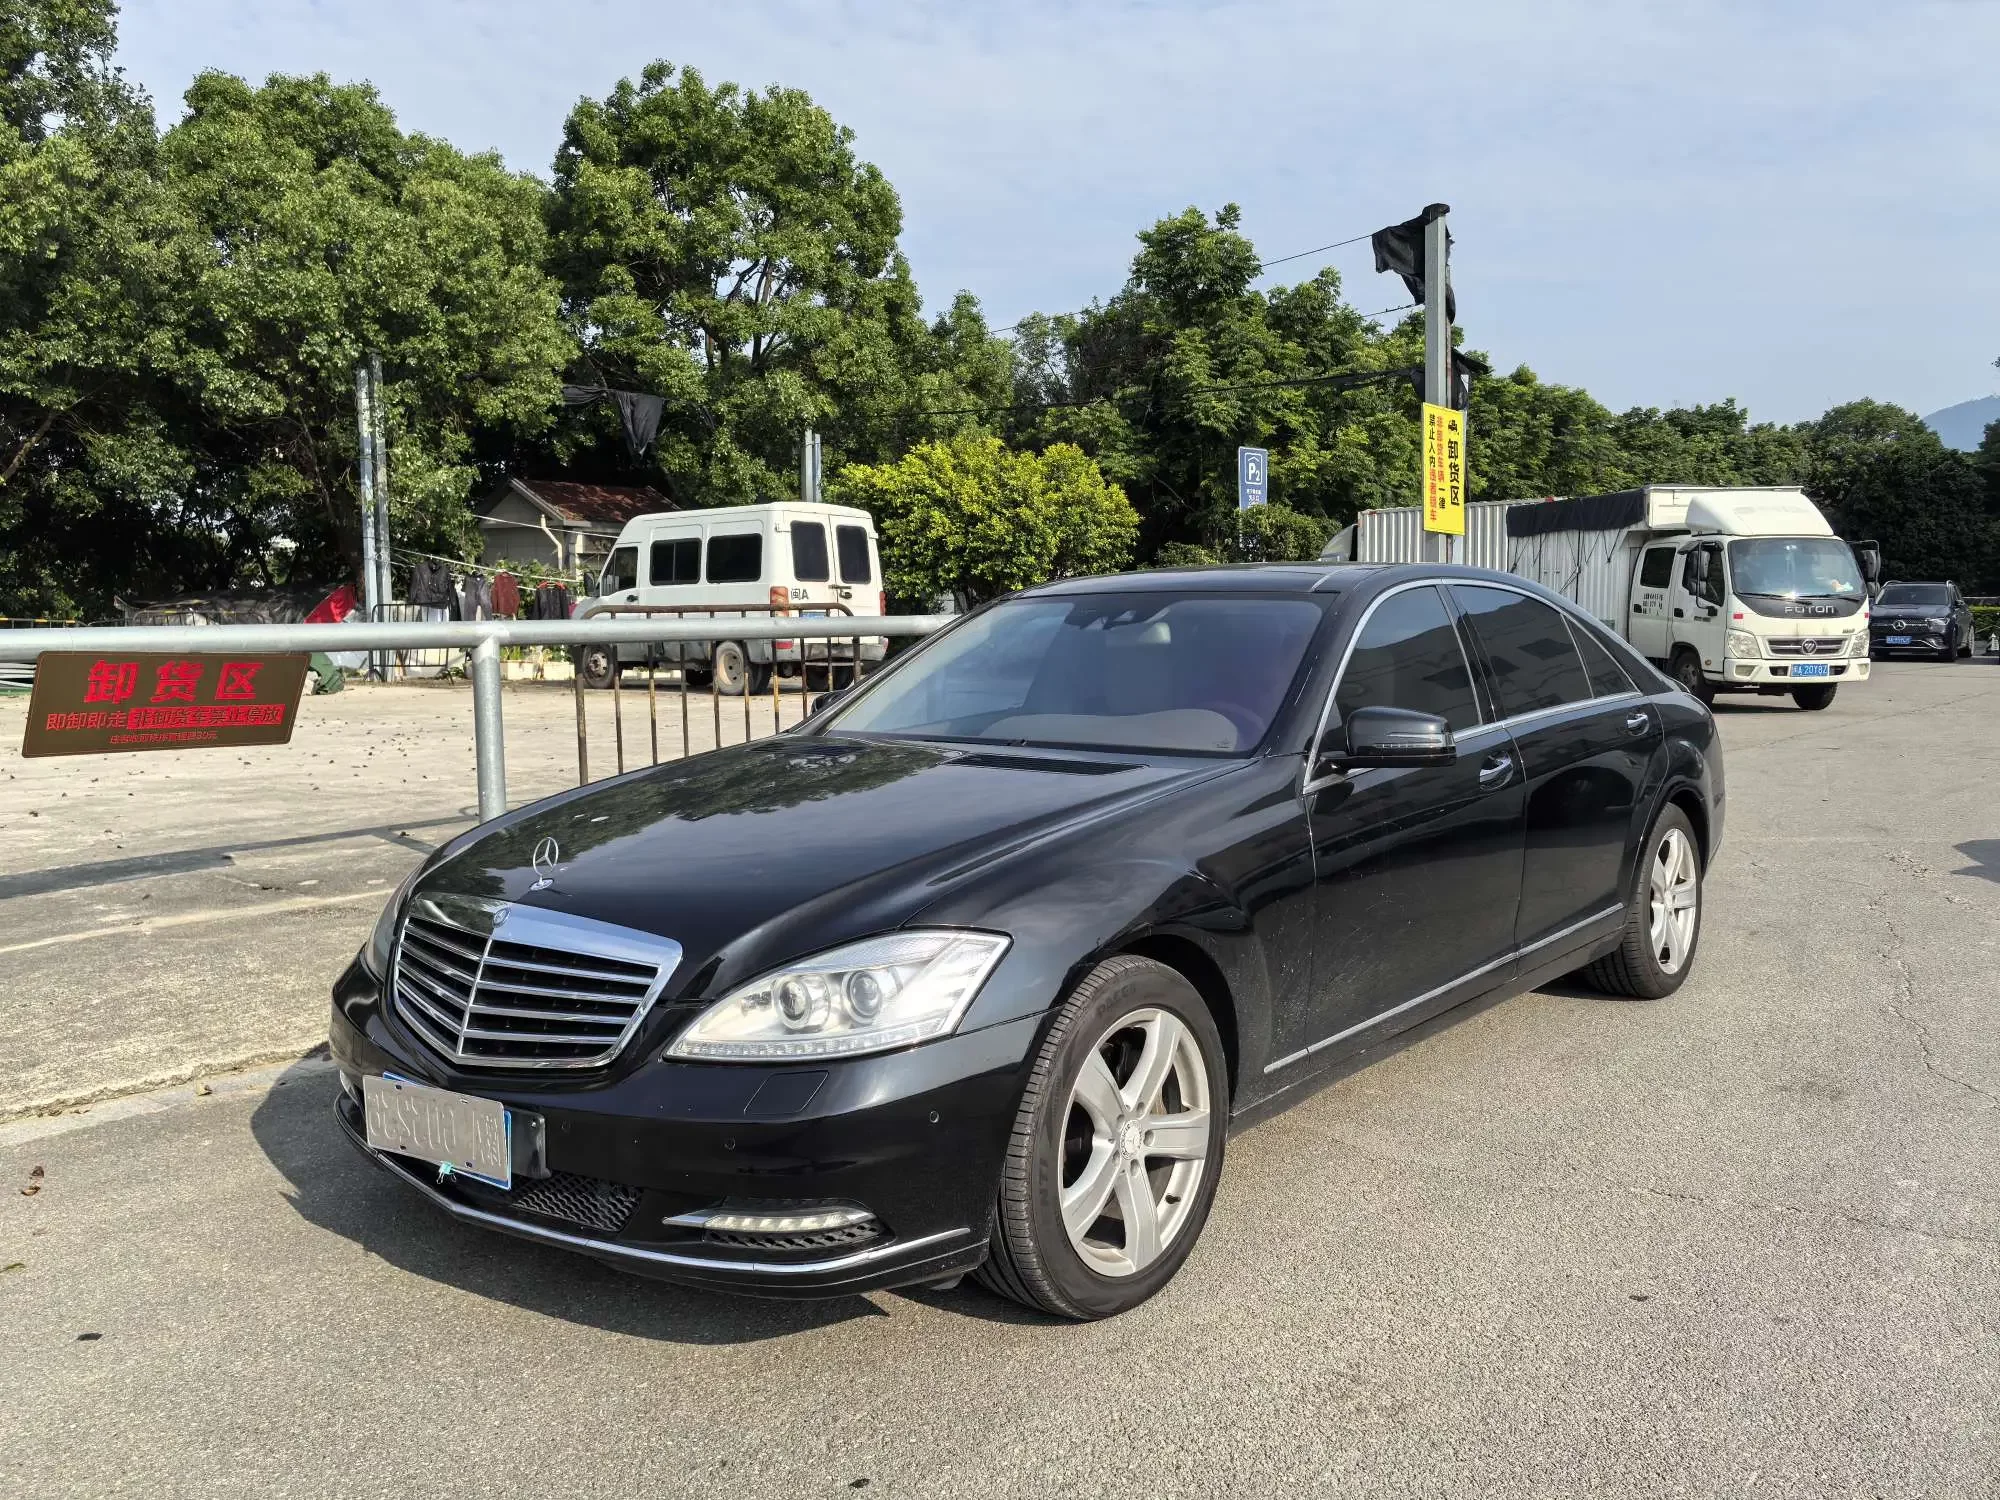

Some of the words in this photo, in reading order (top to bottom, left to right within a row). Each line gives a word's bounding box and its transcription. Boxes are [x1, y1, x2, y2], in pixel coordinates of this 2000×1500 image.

[791, 588, 809, 600] 闽A
[1784, 605, 1834, 614] FOTON
[84, 660, 265, 704] 卸货区
[46, 711, 128, 731] 即卸即走
